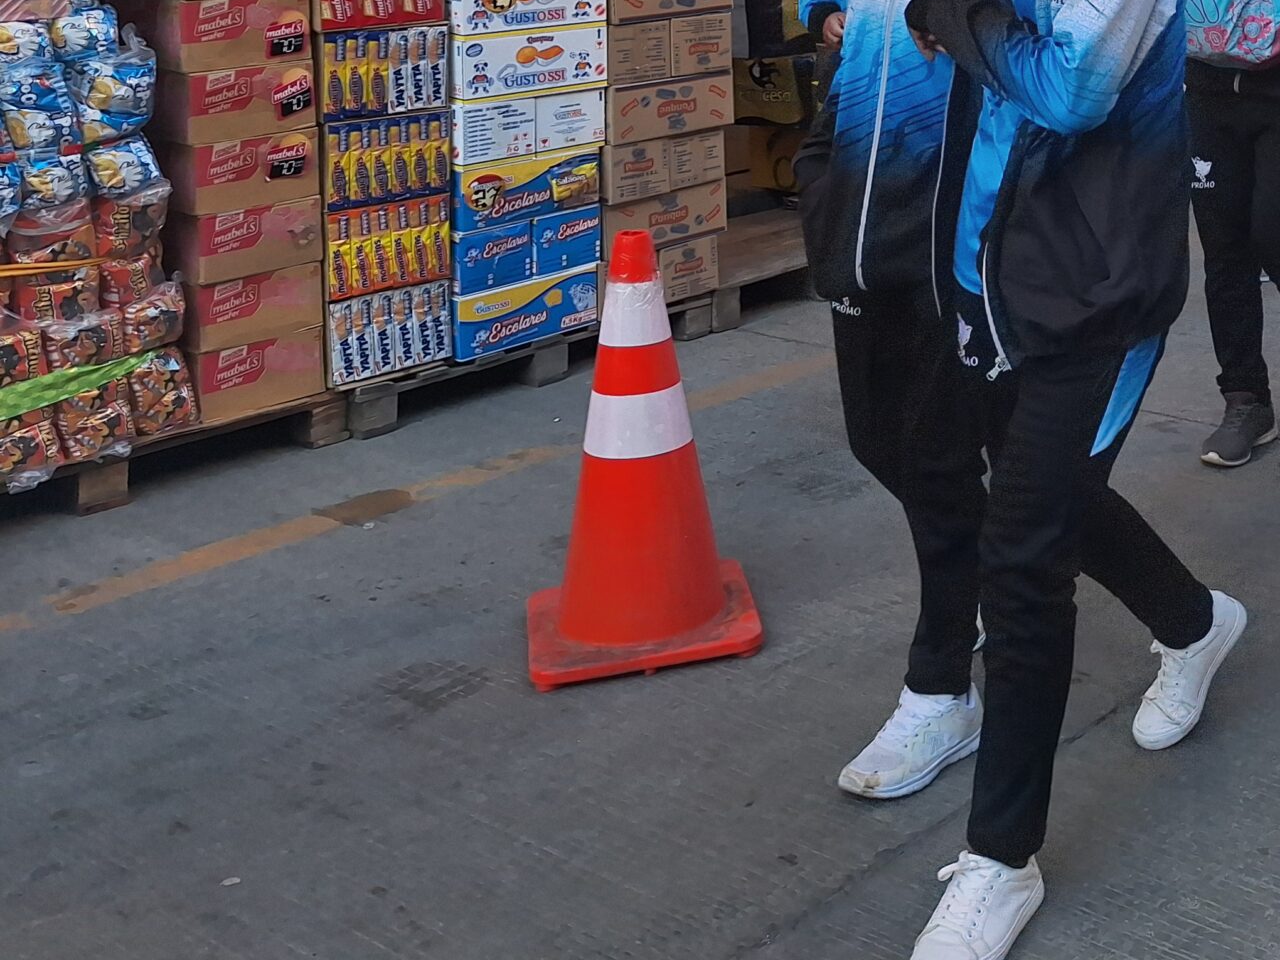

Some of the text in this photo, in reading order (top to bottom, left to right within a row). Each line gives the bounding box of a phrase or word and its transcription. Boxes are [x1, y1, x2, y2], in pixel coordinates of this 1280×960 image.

[503, 8, 565, 25] GUSTOSSI
[411, 63, 424, 104] YAPITA
[431, 62, 442, 103] YAPITA
[503, 69, 565, 87] GUSTOSSI
[491, 189, 551, 218] Escolares
[556, 216, 599, 240] Escolares
[488, 311, 547, 343] Escolares
